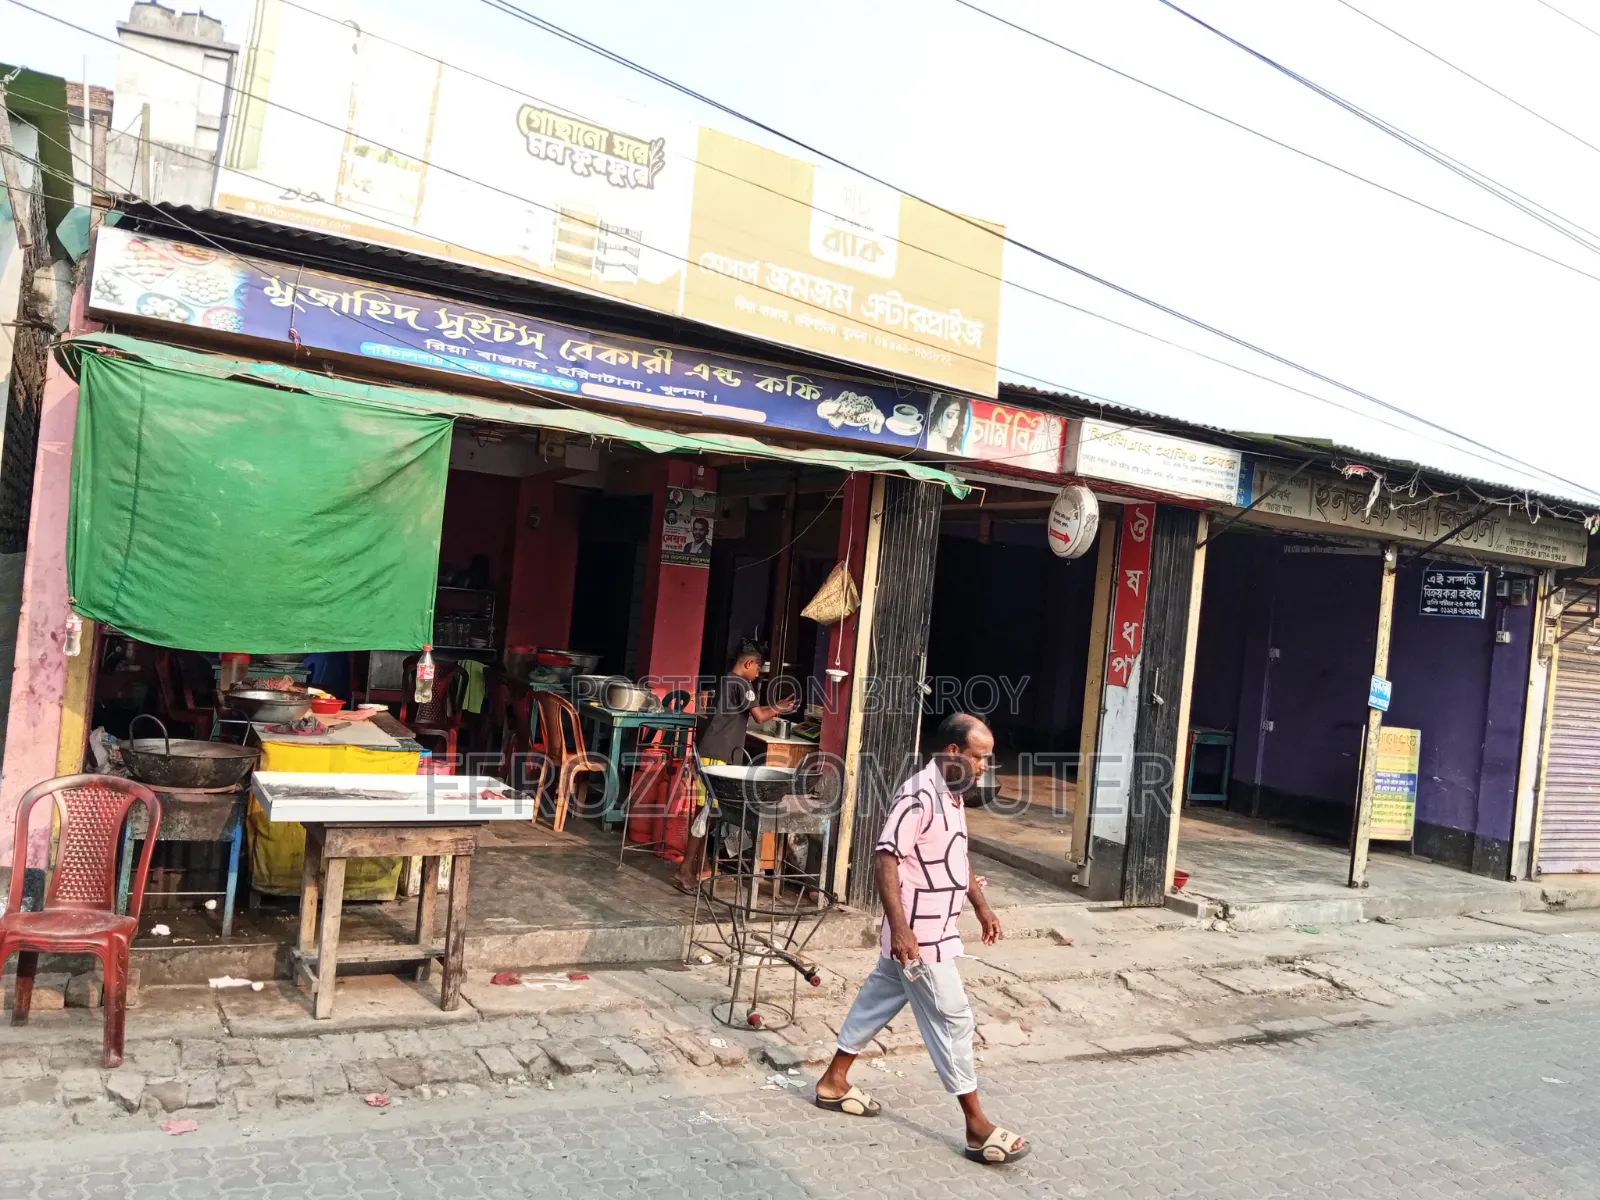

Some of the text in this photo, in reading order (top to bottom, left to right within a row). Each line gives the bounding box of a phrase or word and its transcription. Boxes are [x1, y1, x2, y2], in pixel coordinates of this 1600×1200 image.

[518, 104, 650, 165] গোছানো ঘরে
[699, 252, 760, 280] মেসার্স
[764, 261, 853, 311] জমজম
[261, 276, 429, 331] মুজাহিদ
[560, 339, 673, 376] বেকারী
[753, 374, 823, 401] কফি
[424, 339, 470, 356] রিয়া
[1427, 573, 1476, 585] এই সম্পত্তি
[1459, 586, 1481, 600] হইবে
